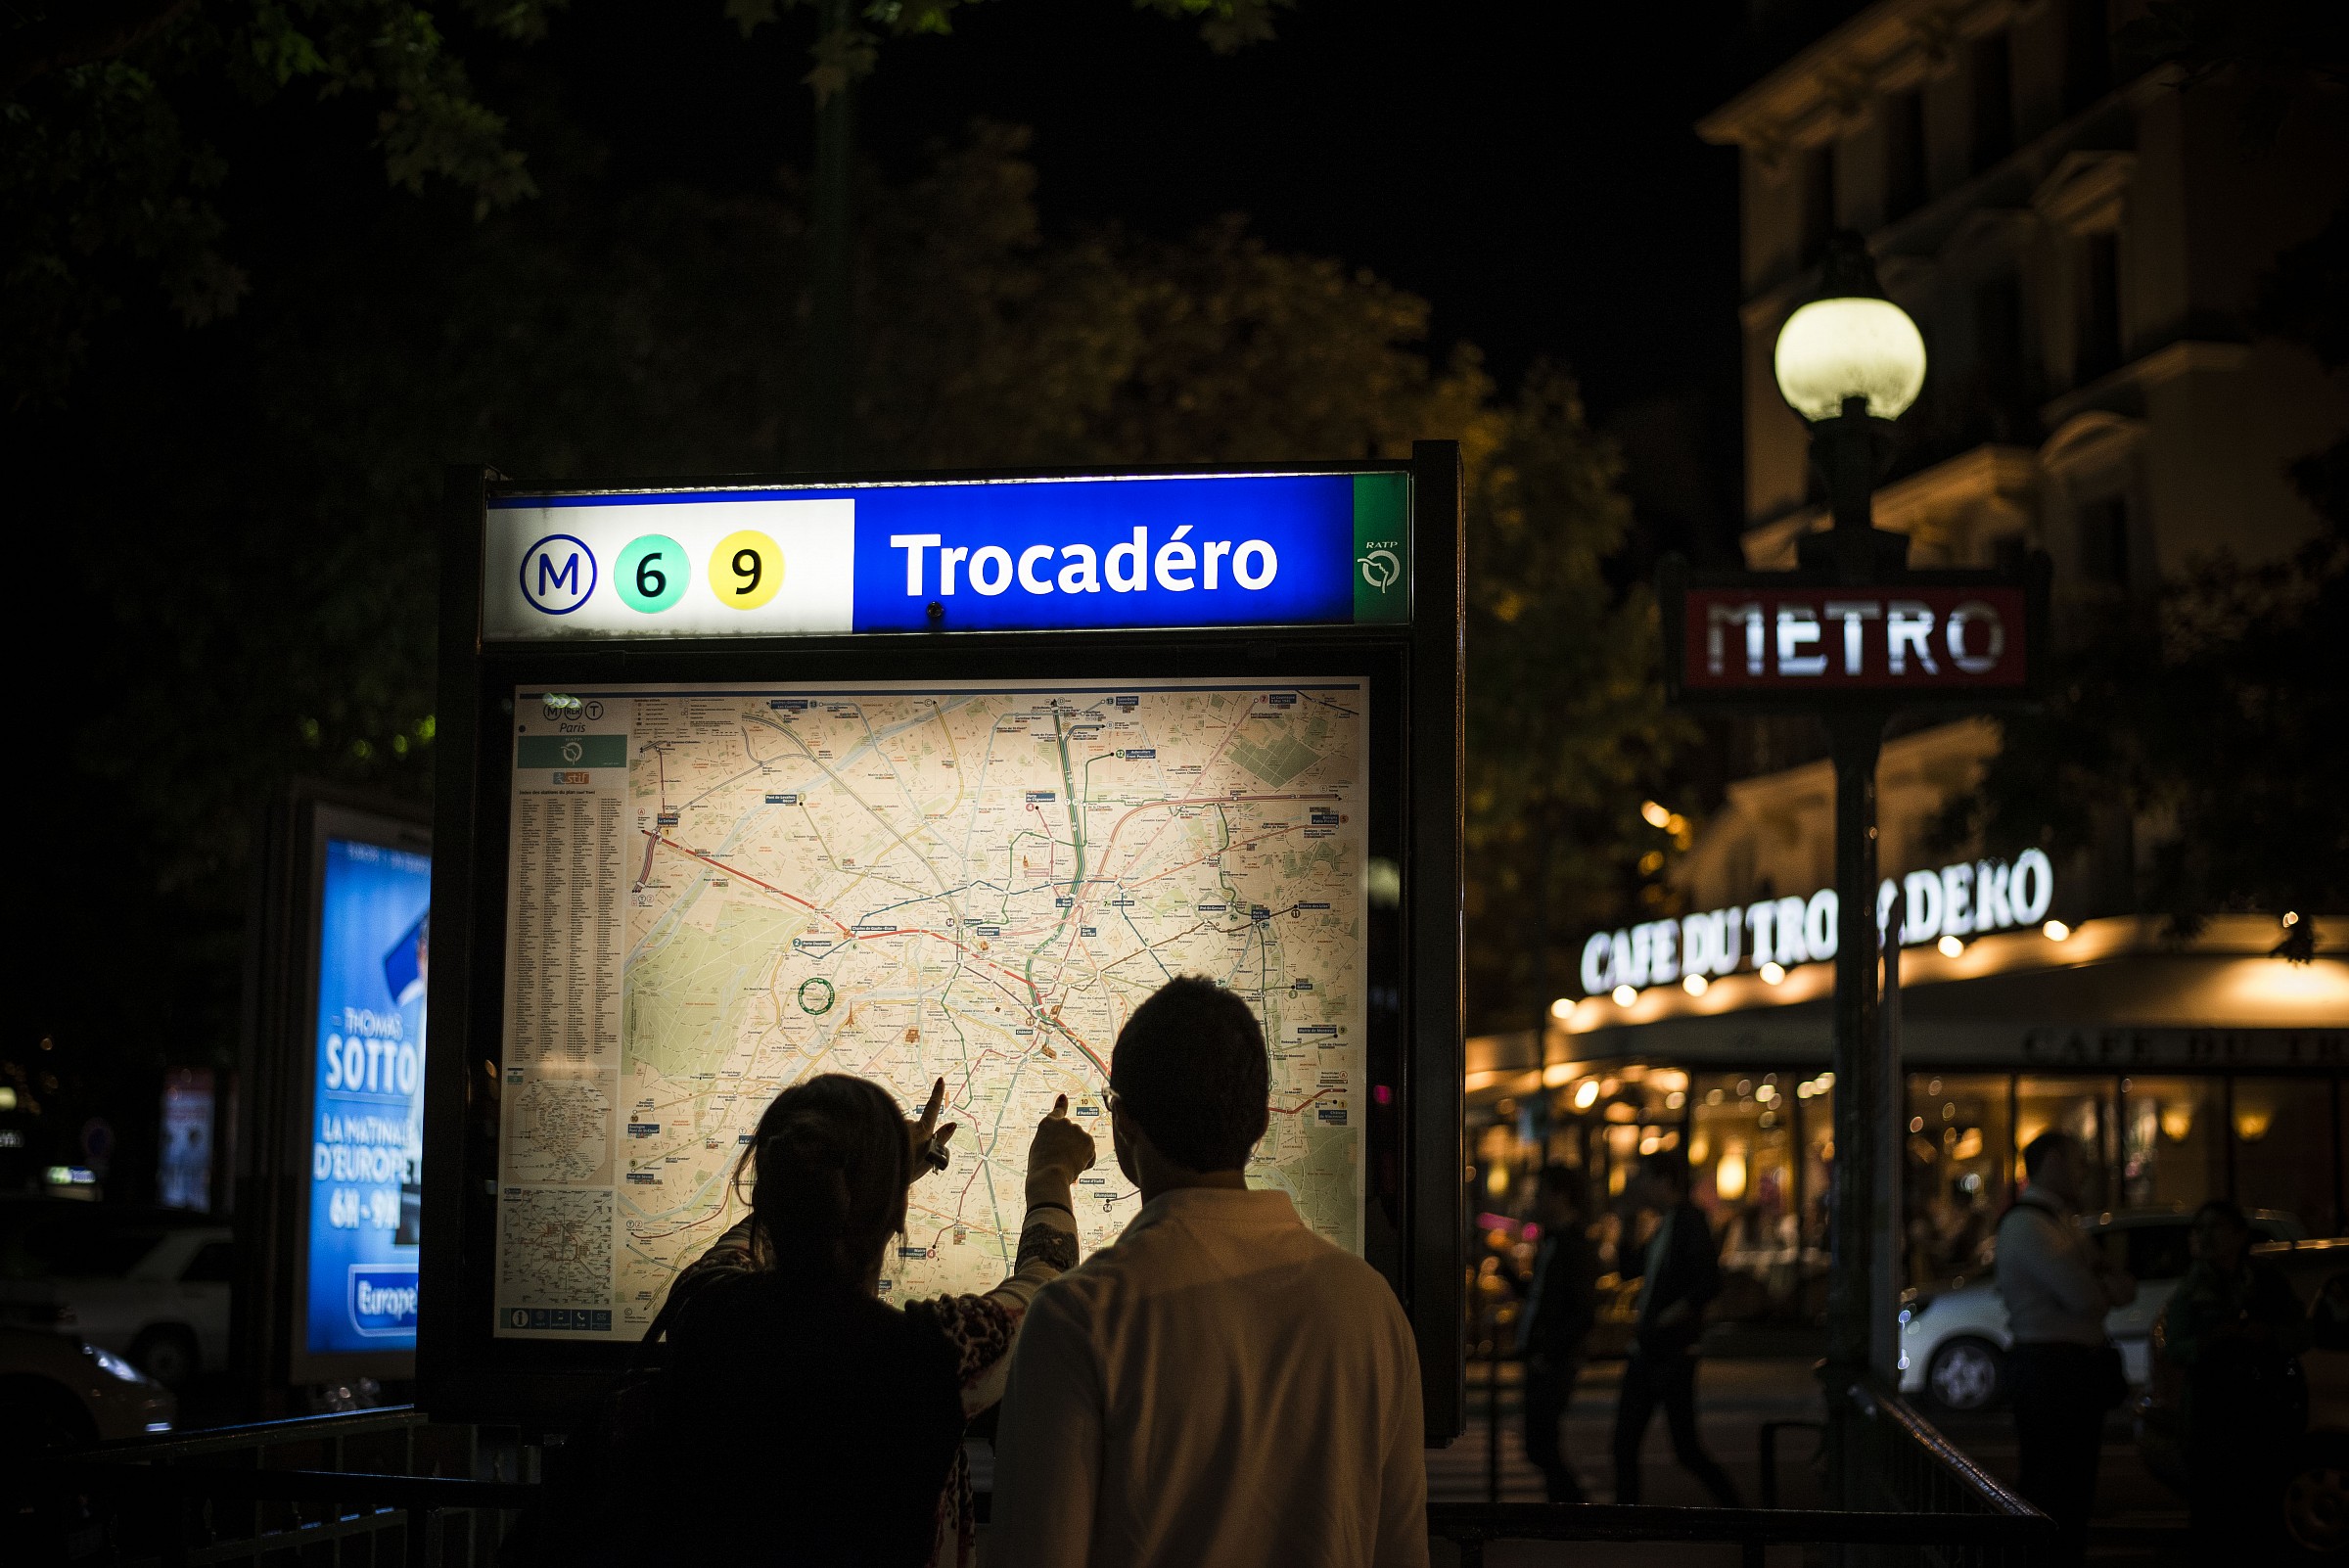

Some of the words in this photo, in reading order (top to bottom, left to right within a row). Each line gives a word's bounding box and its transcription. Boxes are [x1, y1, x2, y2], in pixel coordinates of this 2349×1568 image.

[539, 553, 578, 596] M
[636, 553, 667, 598] 6
[732, 548, 762, 595] 9
[890, 525, 1277, 597] Trocadéro
[1708, 600, 2004, 676] METRO
[560, 722, 586, 733] Paris
[590, 706, 599, 716] T
[568, 772, 589, 783] stif
[1581, 920, 1680, 995] CAFE
[1682, 906, 1743, 976] DU
[345, 1006, 403, 1041] THOMAS
[325, 1033, 418, 1095] SOTTO
[2022, 1030, 2150, 1065] CAFE
[2188, 1030, 2252, 1065] DU
[322, 1113, 343, 1143] LA
